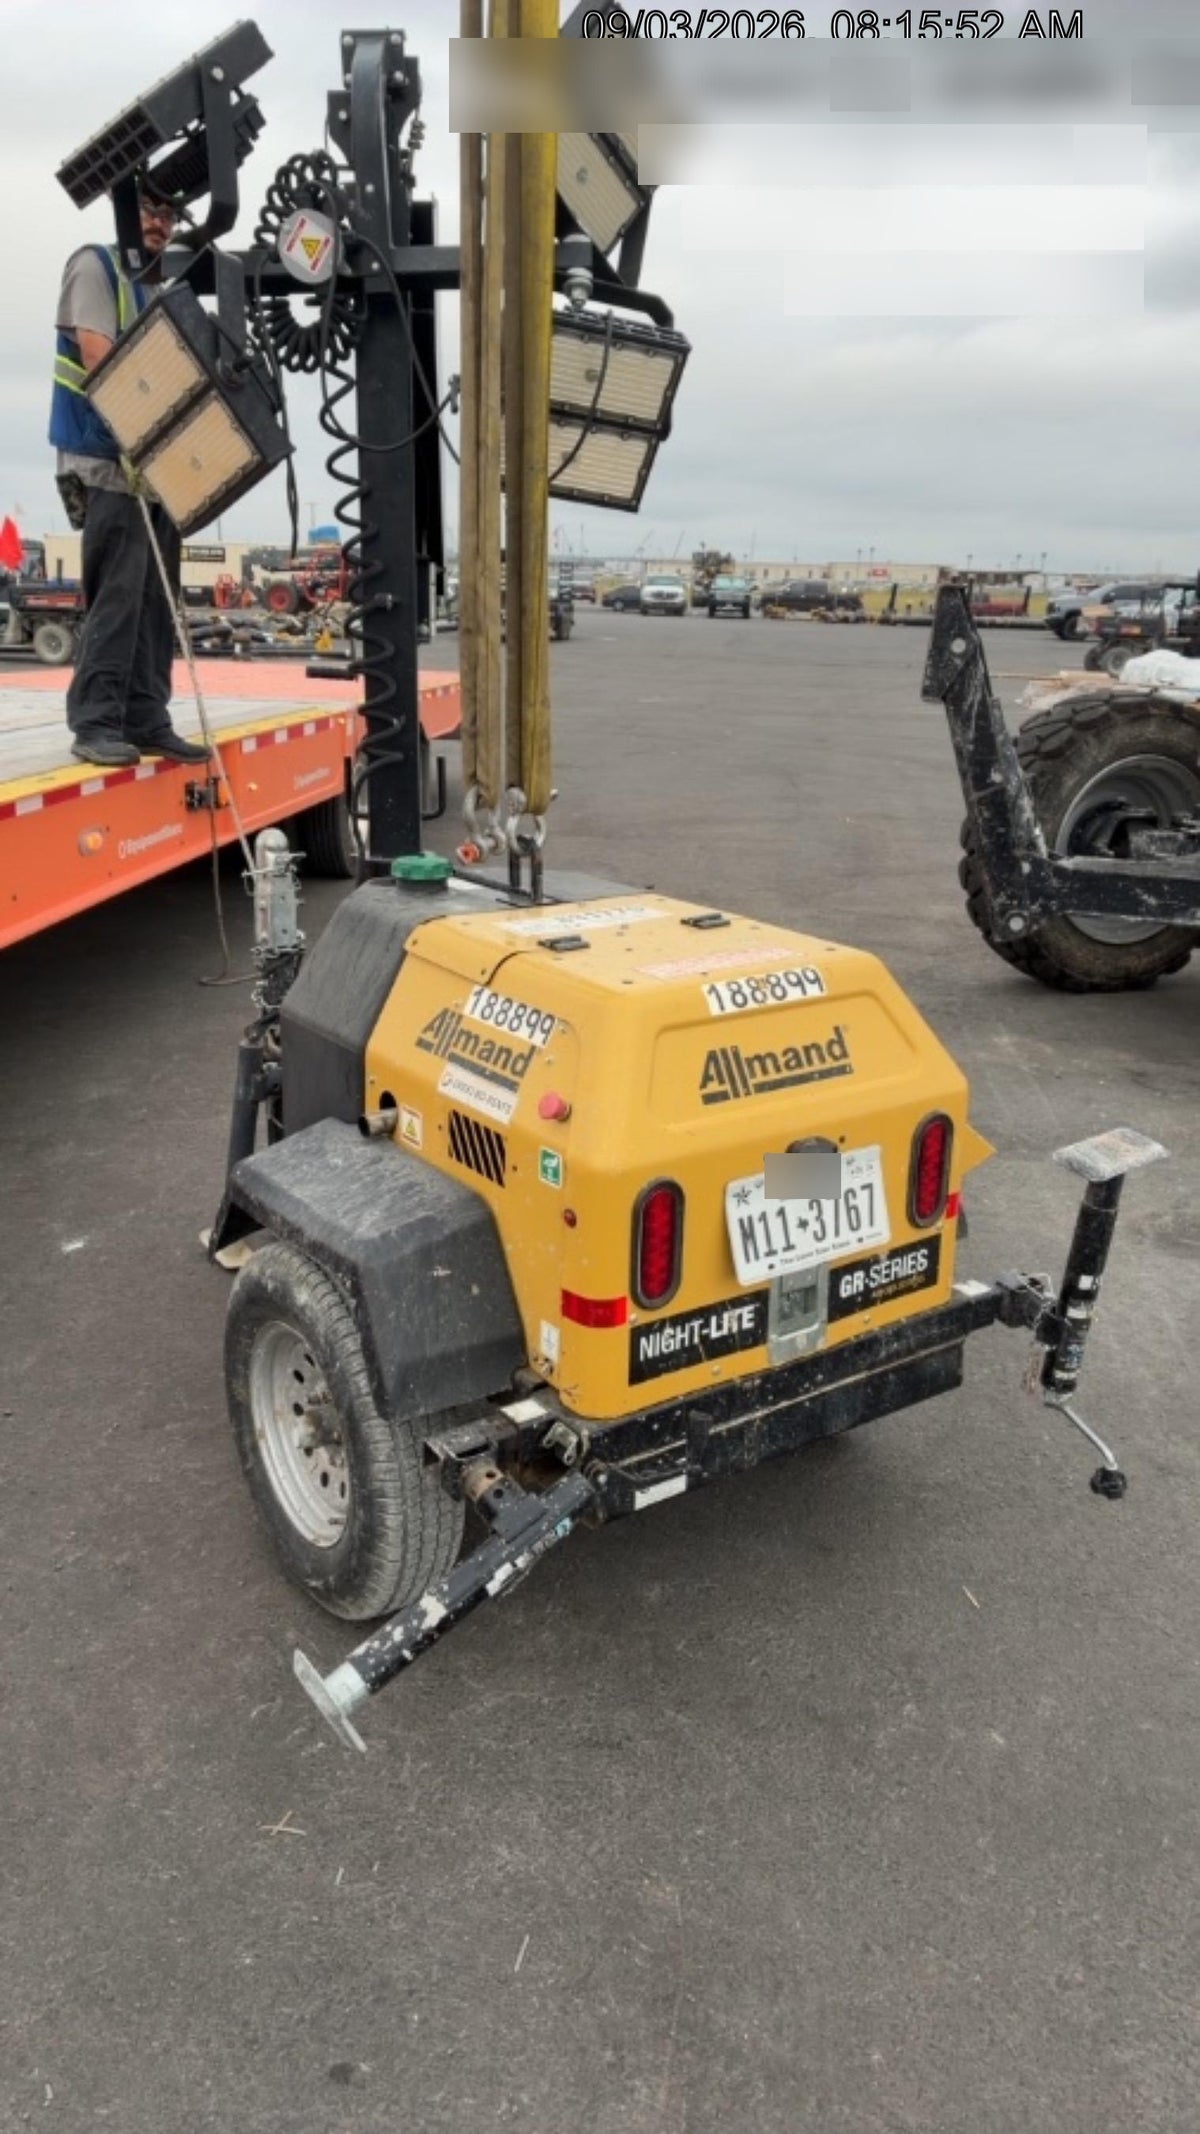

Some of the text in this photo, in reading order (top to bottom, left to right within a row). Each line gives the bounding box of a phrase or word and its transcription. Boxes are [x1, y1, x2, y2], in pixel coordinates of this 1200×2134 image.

[469, 987, 556, 1044] 188899
[706, 967, 824, 1012] 188899
[420, 1007, 537, 1079] Allmand
[699, 1025, 848, 1098] Allmand
[639, 1304, 757, 1362] NIGHT-LITE
